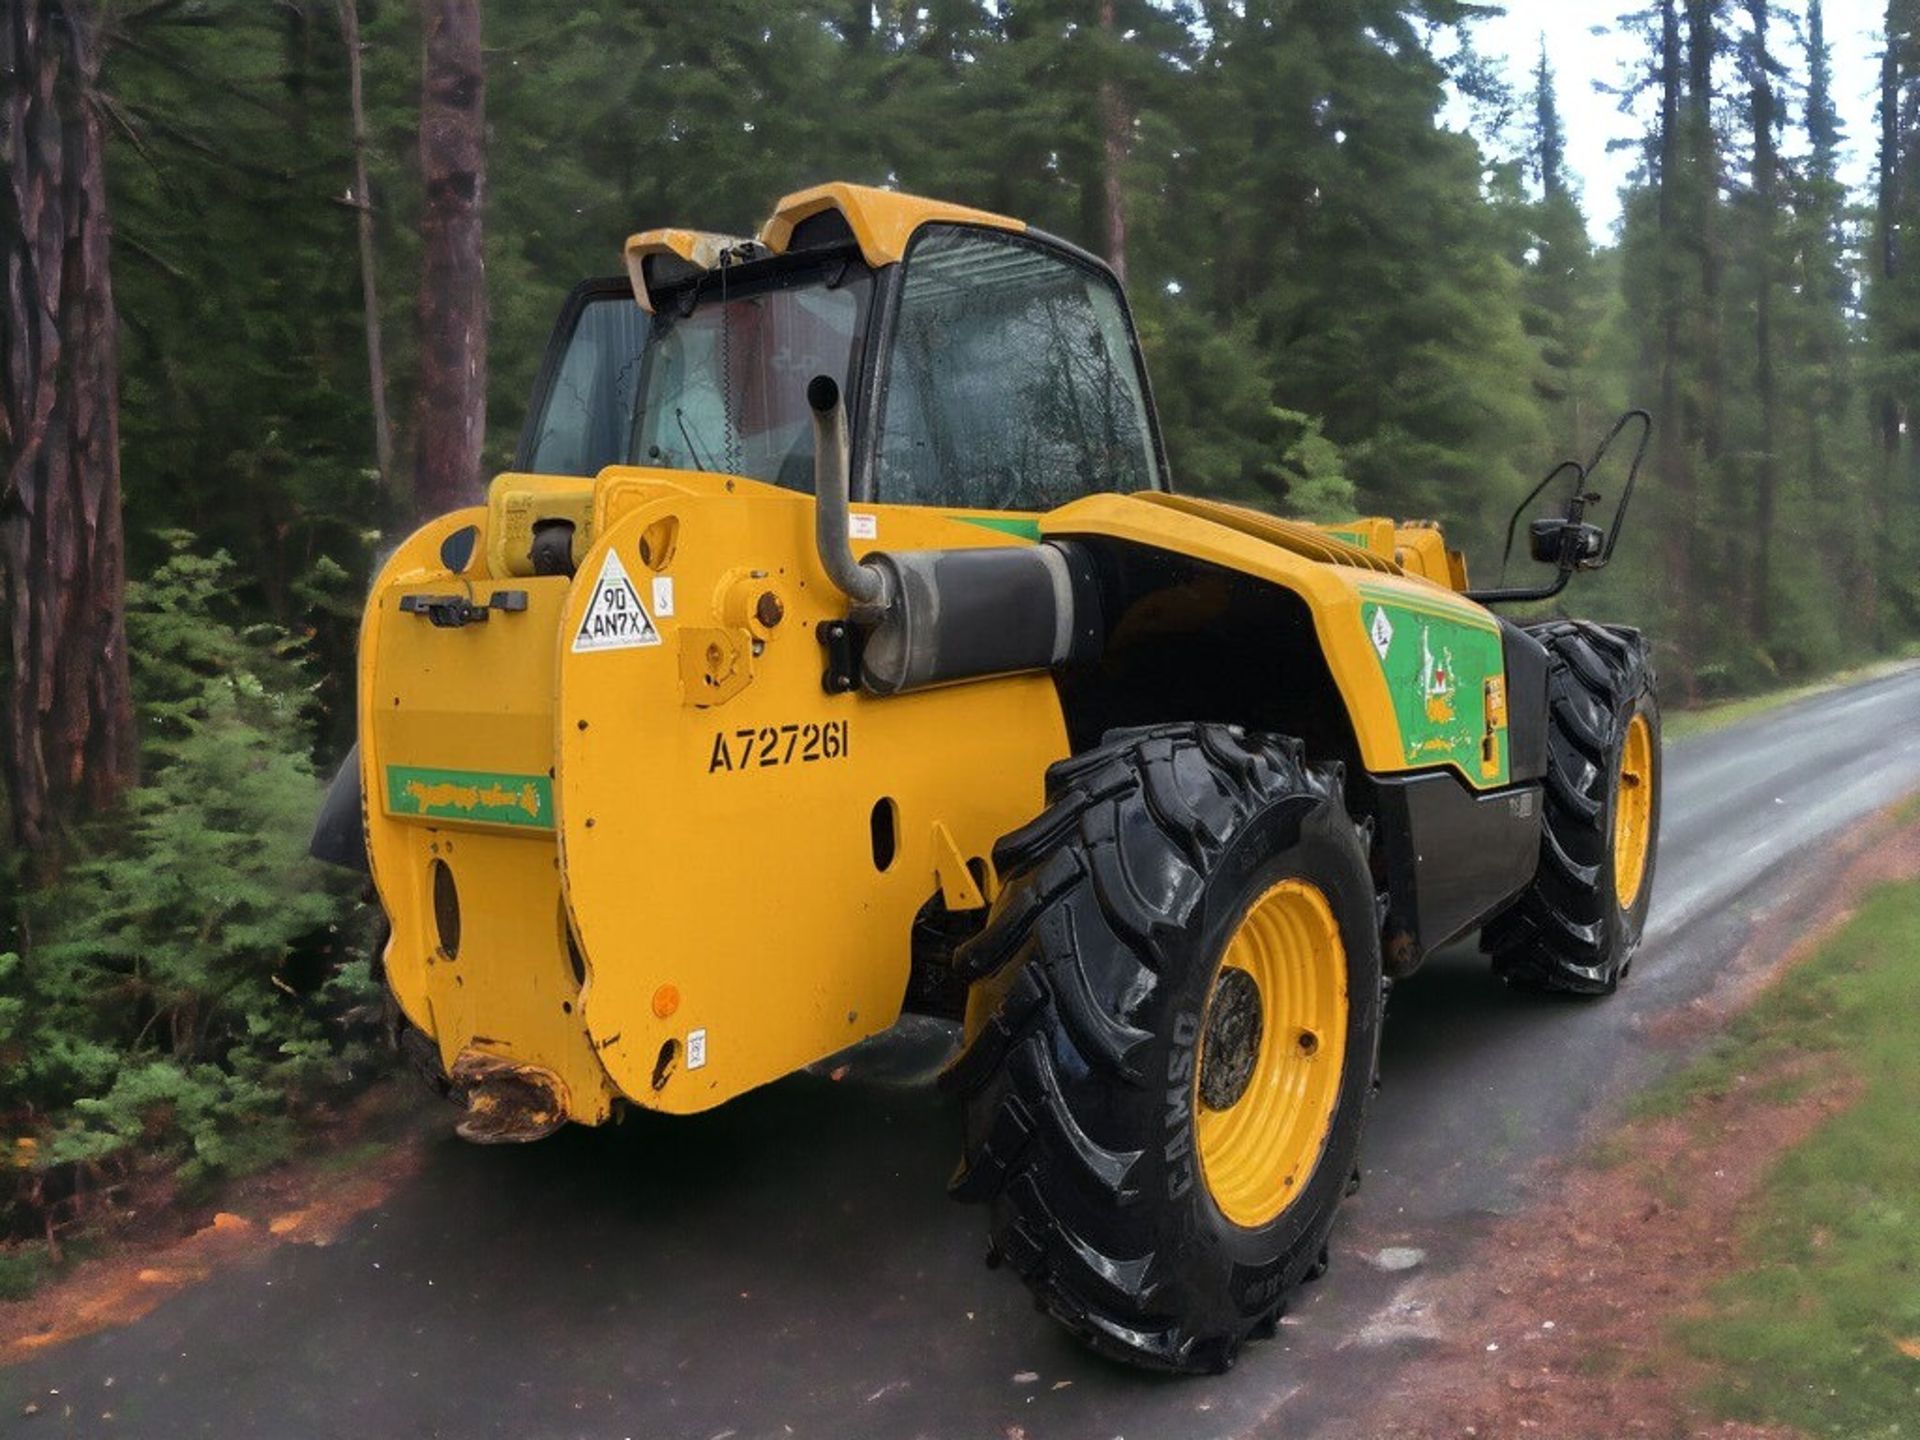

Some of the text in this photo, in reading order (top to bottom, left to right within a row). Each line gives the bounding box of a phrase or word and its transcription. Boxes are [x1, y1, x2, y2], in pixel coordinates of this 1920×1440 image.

[594, 612, 640, 637] AN7X
[708, 720, 847, 773] A727261
[1163, 1010, 1199, 1202] CAMSO
